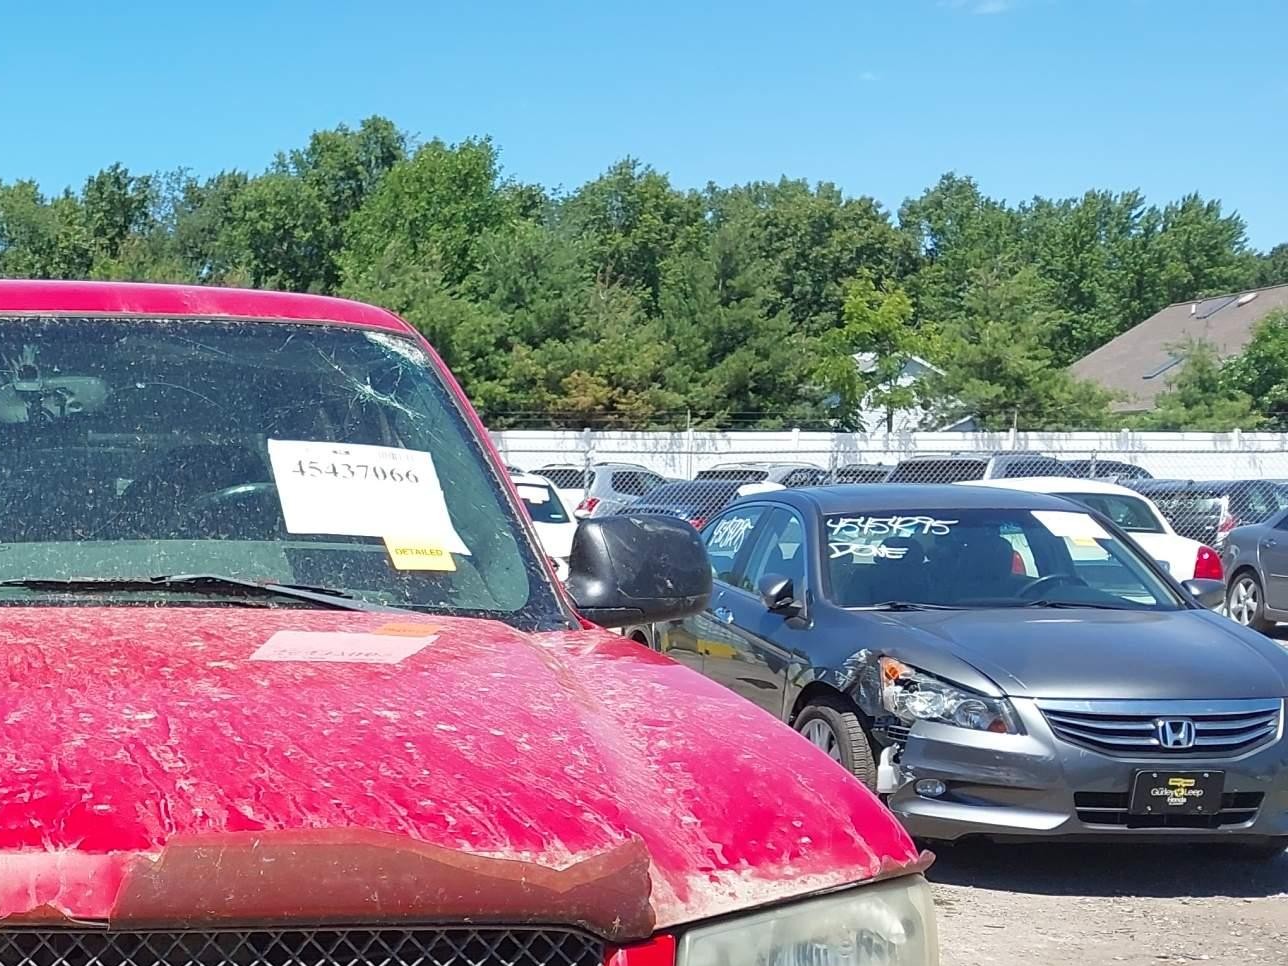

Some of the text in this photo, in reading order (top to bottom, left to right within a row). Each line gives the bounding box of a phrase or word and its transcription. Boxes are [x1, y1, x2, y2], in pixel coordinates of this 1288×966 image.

[291, 459, 420, 484] 45437066
[394, 548, 443, 557] DETAILED
[828, 542, 909, 559] DONE
